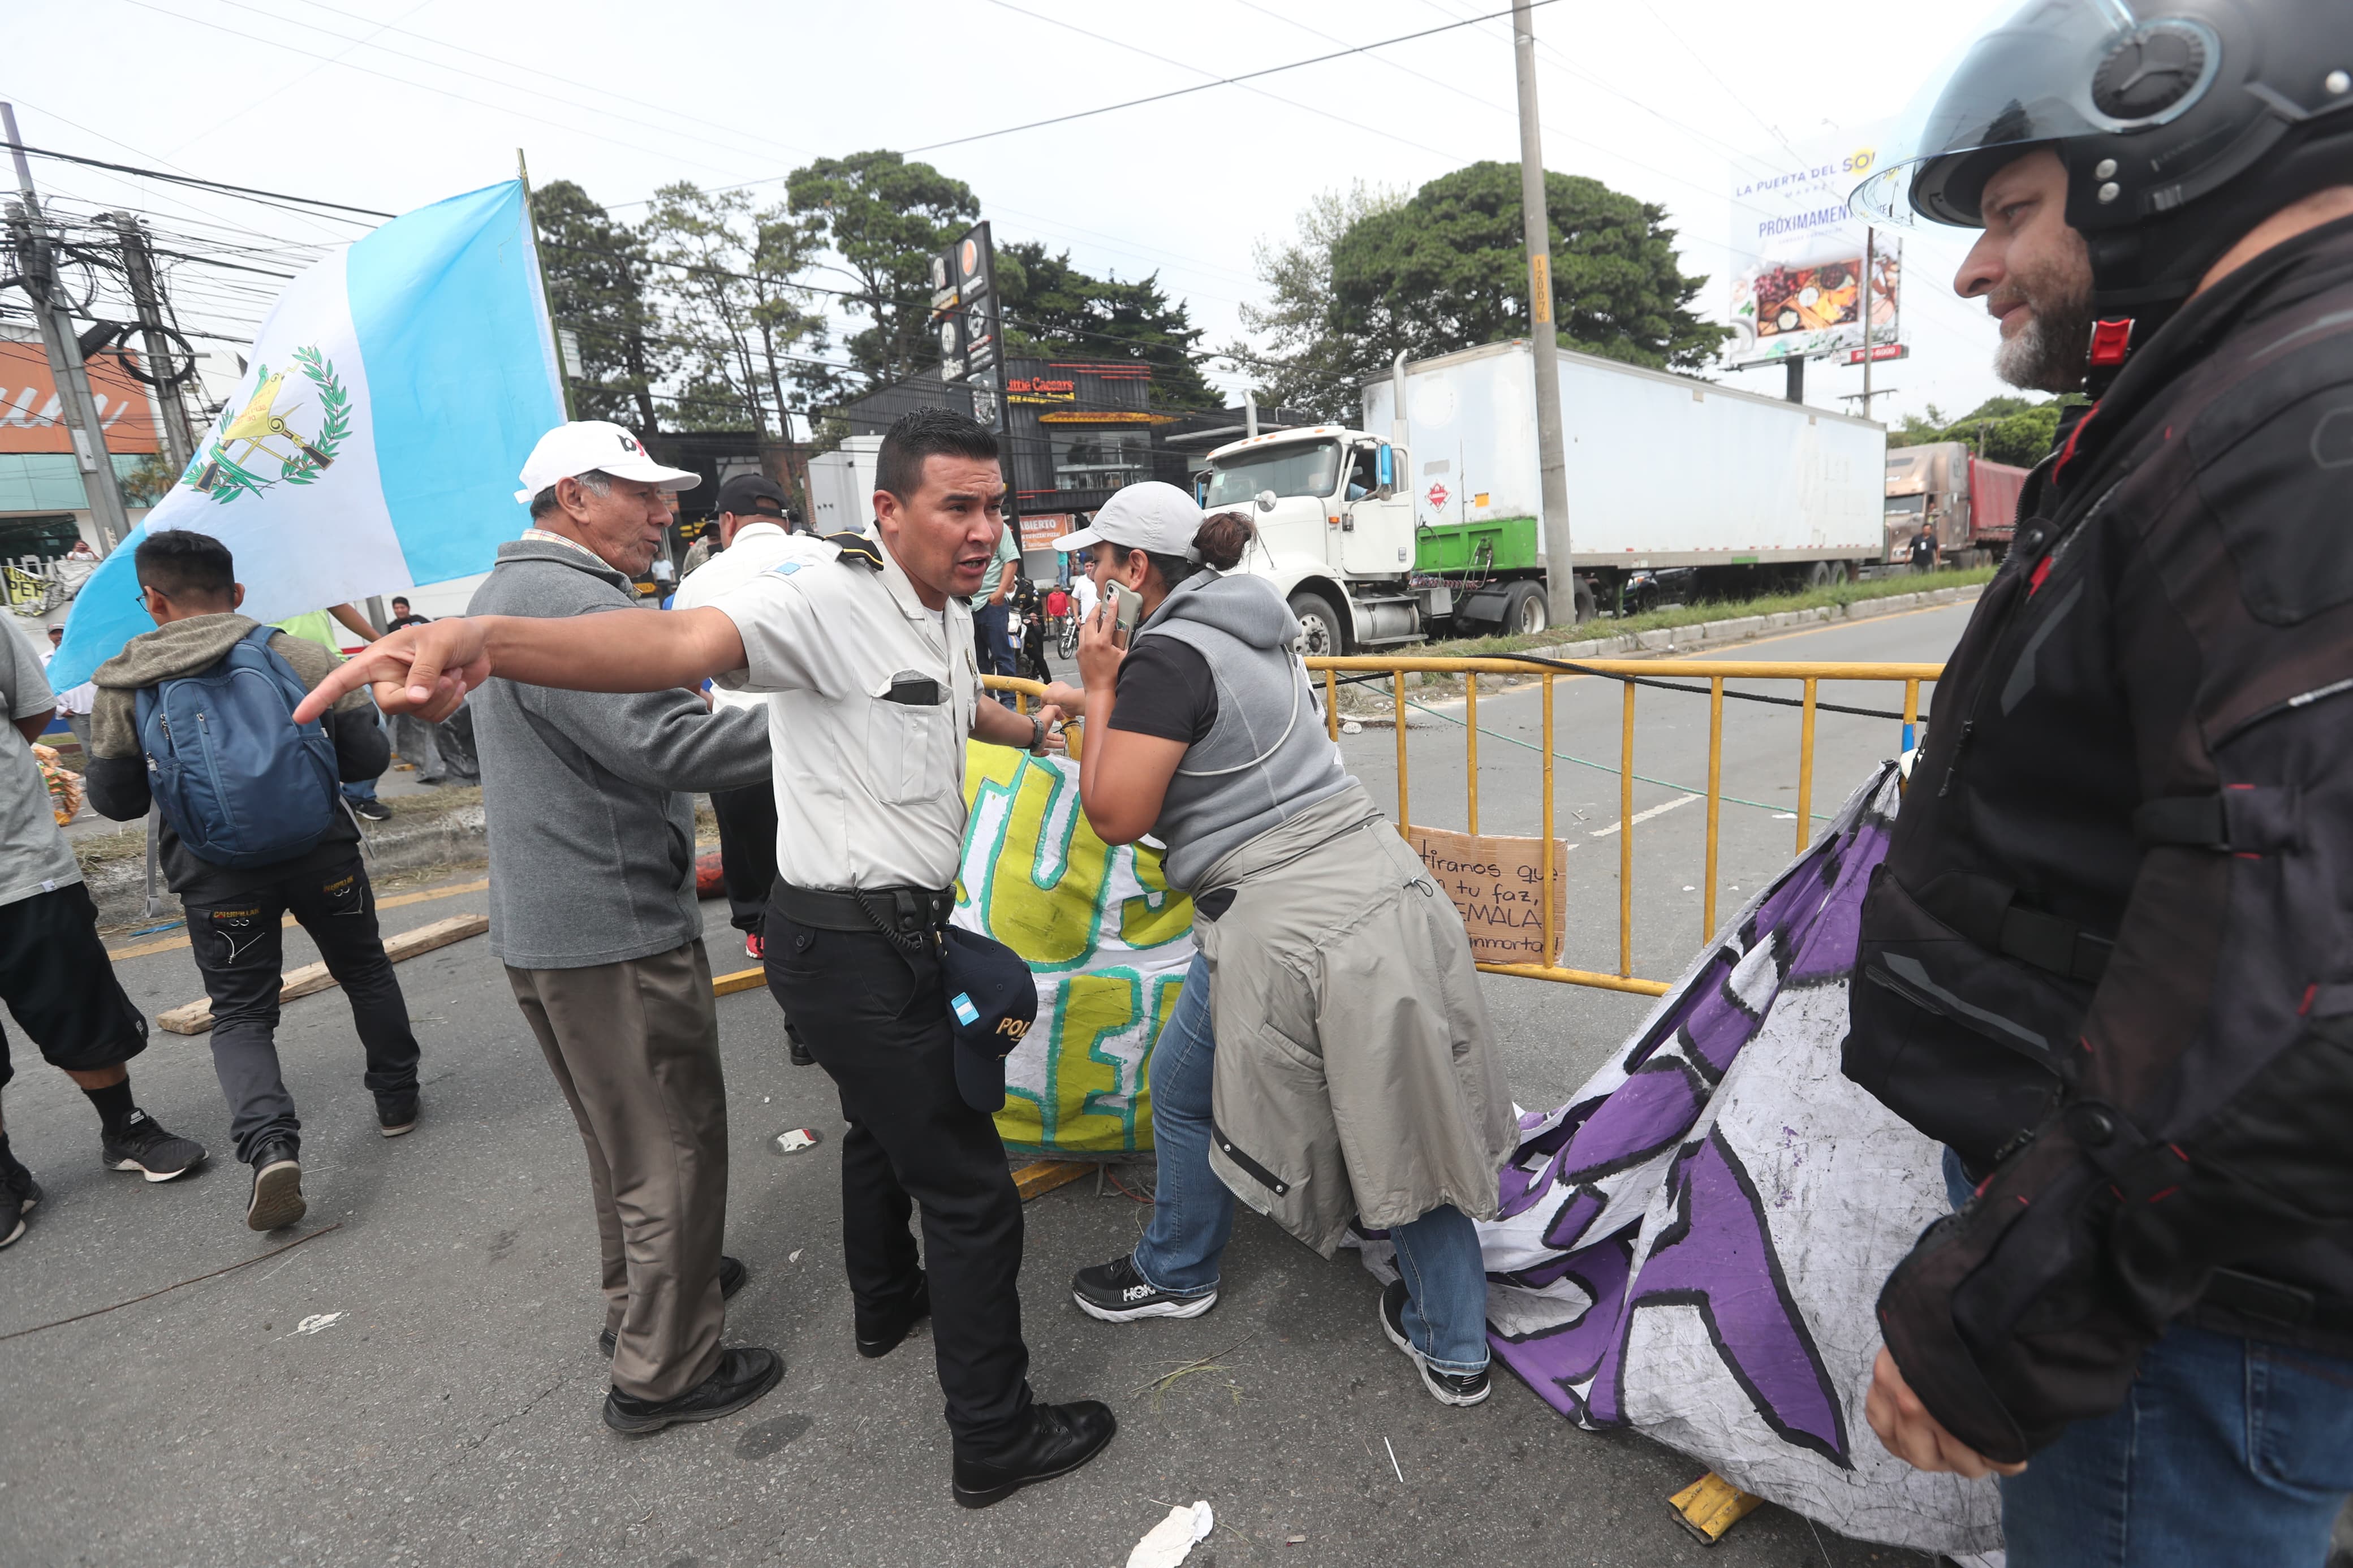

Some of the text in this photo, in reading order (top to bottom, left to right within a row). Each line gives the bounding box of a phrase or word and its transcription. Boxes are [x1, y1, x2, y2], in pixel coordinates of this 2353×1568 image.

[1737, 185, 1752, 197] LA
[1757, 172, 1806, 192] PUERTA
[1811, 164, 1837, 178] DEL
[1032, 377, 1074, 391] Caesars
[1419, 839, 1501, 878] tiranos
[1456, 880, 1480, 897] tu
[1492, 884, 1539, 906] faz,
[1469, 935, 1558, 956] inmorta!
